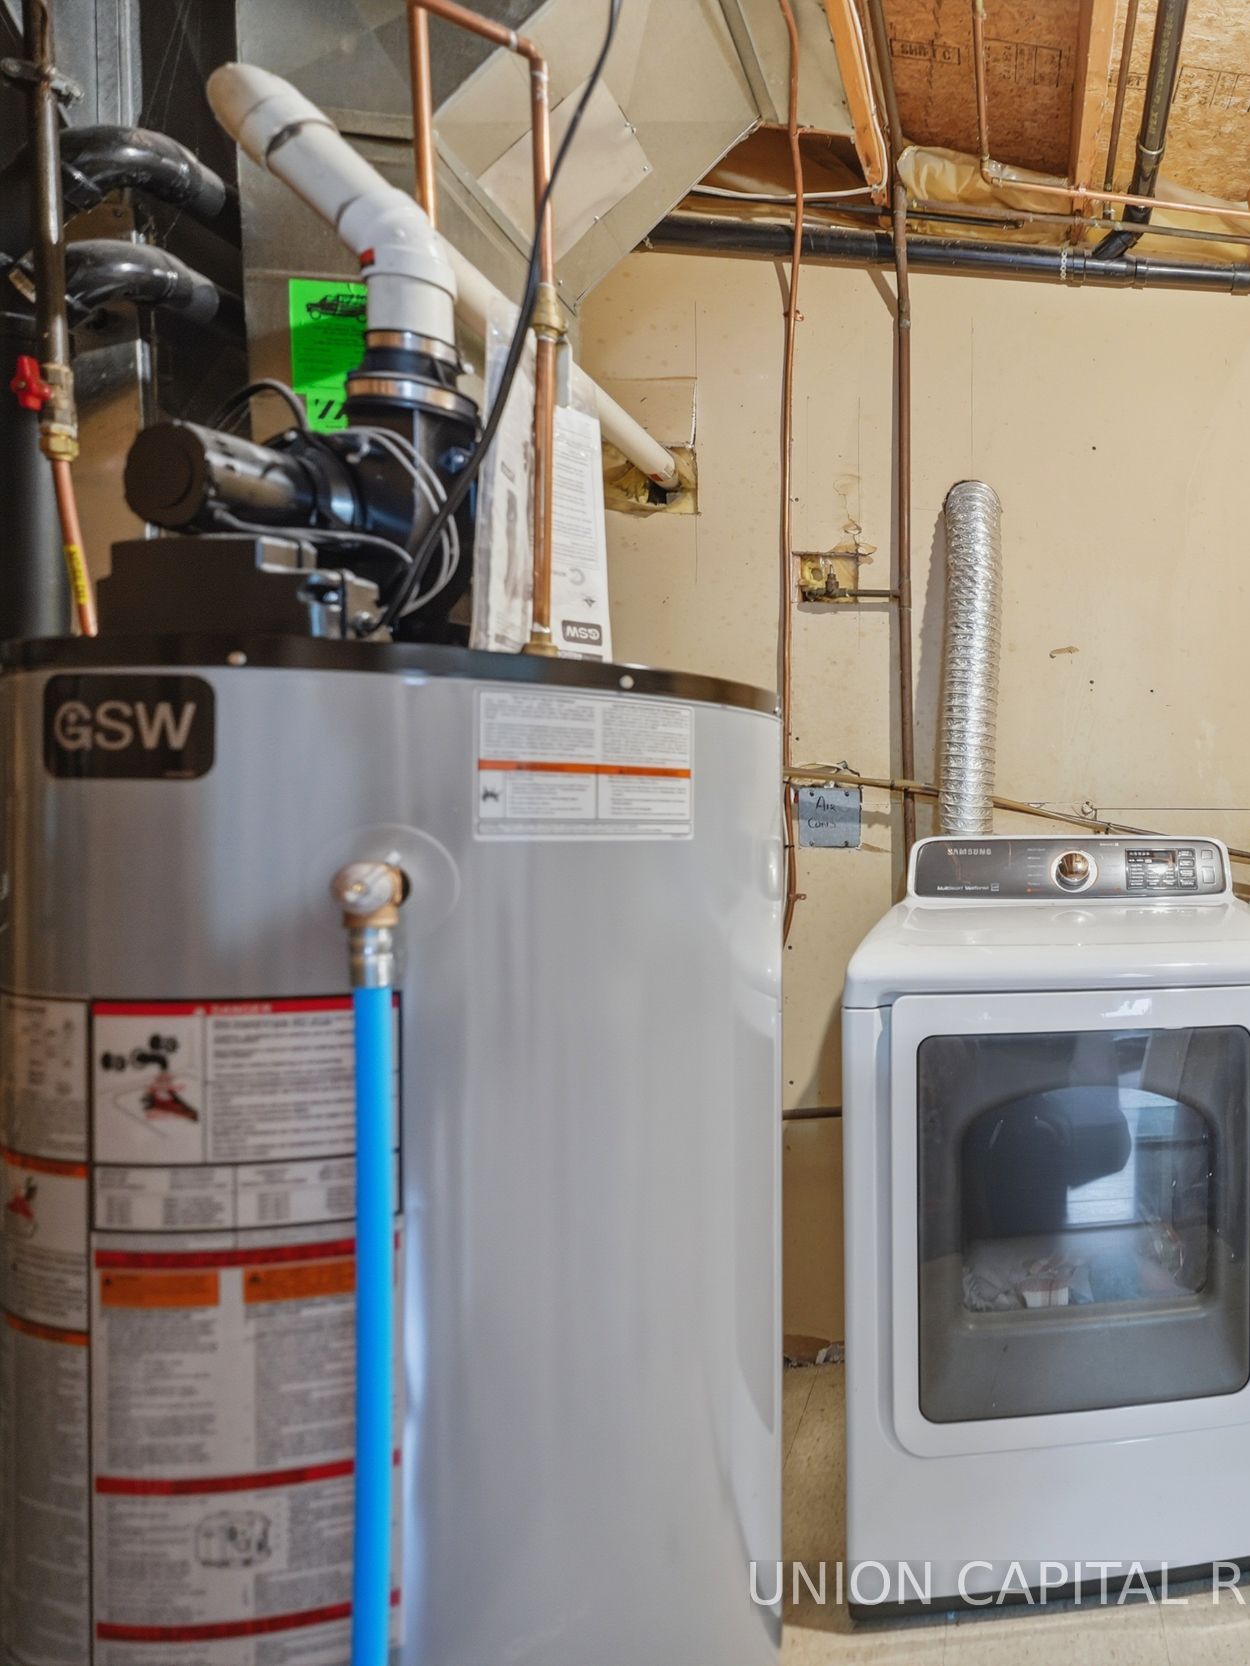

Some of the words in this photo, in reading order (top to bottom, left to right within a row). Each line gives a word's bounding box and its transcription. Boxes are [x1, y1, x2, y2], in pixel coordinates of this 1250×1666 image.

[566, 625, 601, 641] GSW
[54, 700, 197, 751] GSW
[947, 847, 992, 856] SAMSUNG
